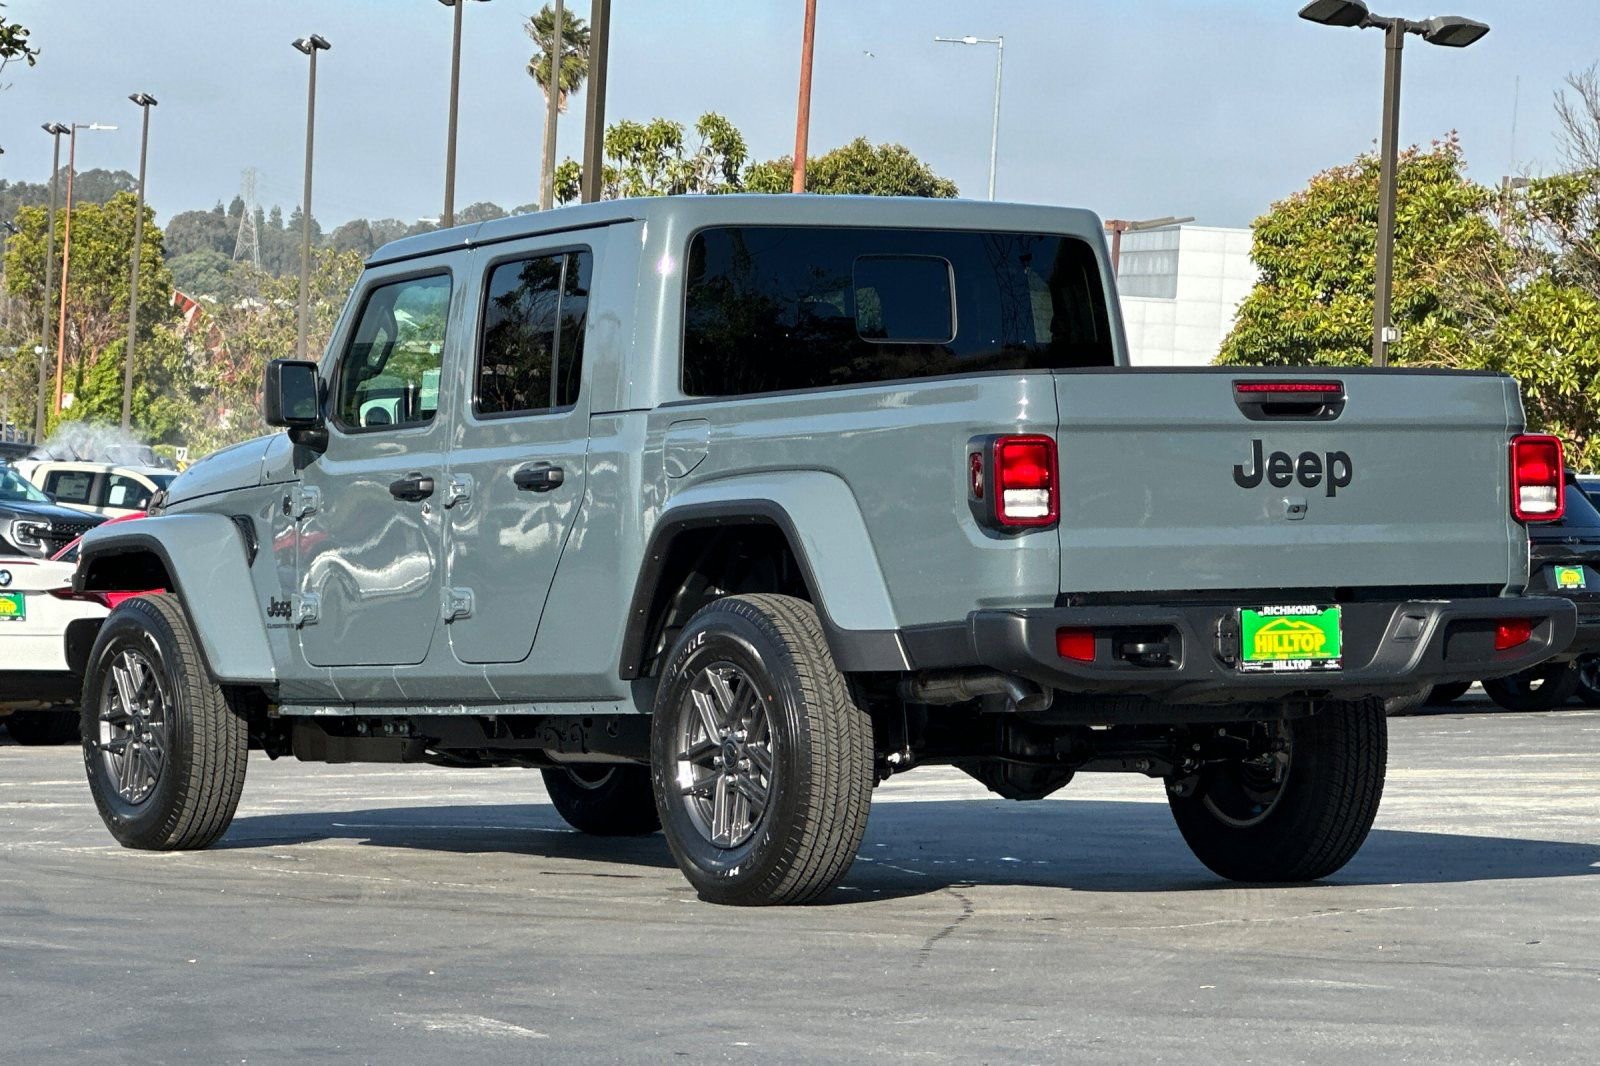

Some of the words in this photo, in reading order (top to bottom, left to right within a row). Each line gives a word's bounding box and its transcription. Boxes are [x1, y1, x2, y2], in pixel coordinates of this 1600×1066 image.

[1233, 439, 1352, 497] Jeep
[1263, 605, 1318, 616] RICHMOND
[1255, 633, 1326, 653] HILLTOP
[1272, 659, 1312, 670] HILLTOP
